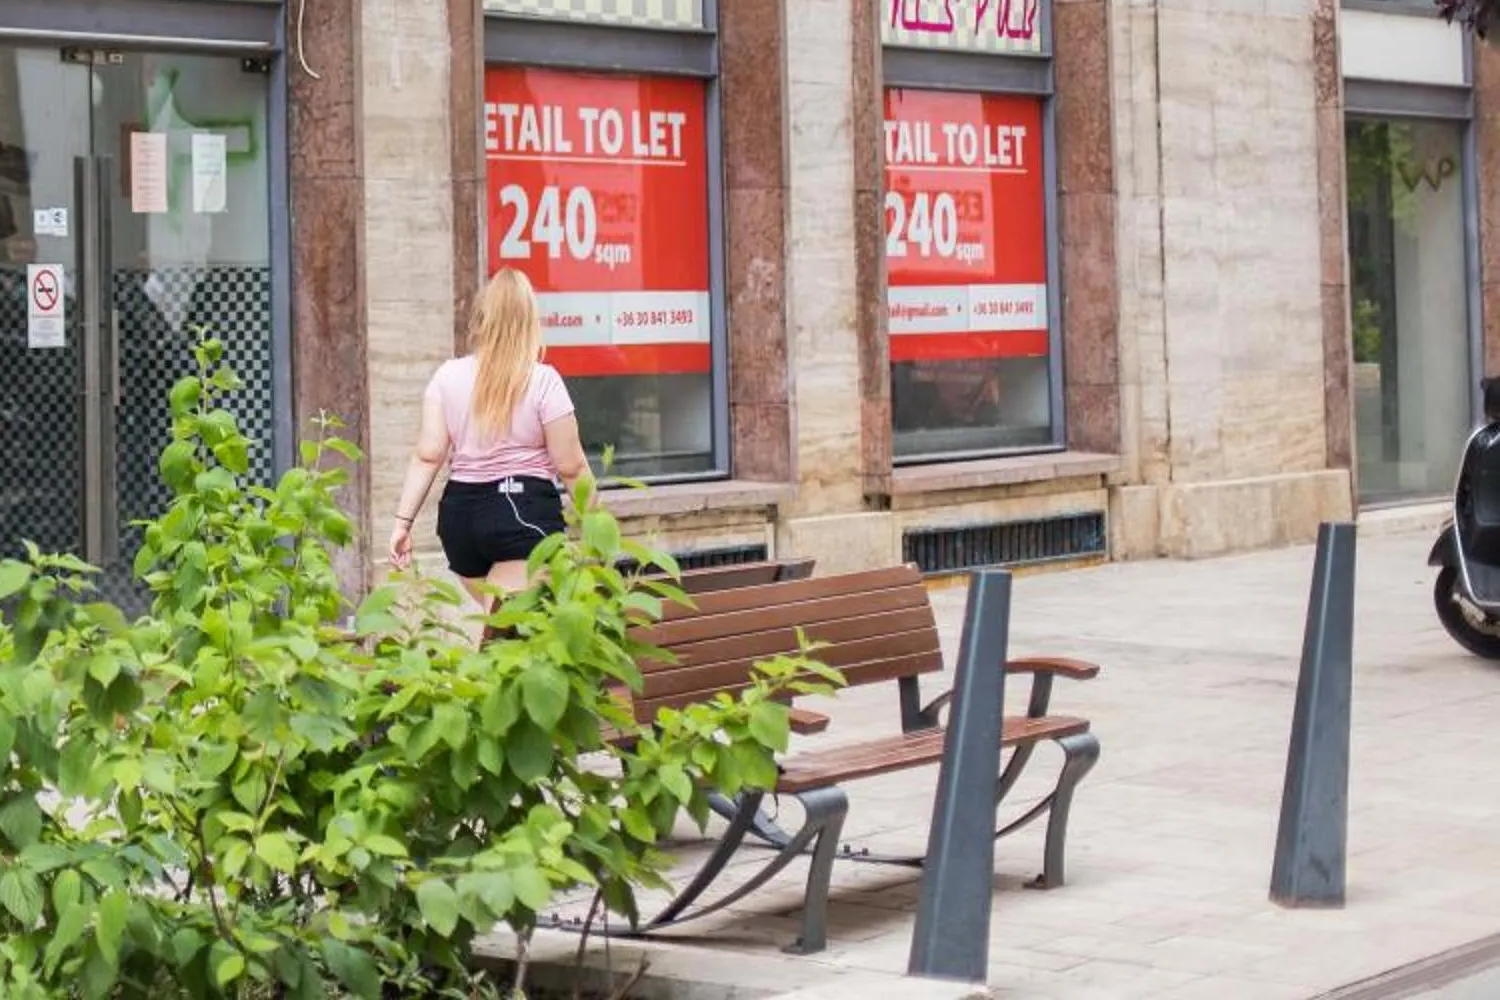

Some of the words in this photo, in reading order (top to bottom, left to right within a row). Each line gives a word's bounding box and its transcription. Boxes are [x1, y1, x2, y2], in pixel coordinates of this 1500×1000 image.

[578, 107, 624, 156] TO
[631, 110, 686, 157] LET
[941, 121, 978, 165] TO
[983, 124, 1026, 166] LET
[499, 184, 596, 260] 240
[595, 243, 631, 271] sqm
[884, 191, 957, 257] 240
